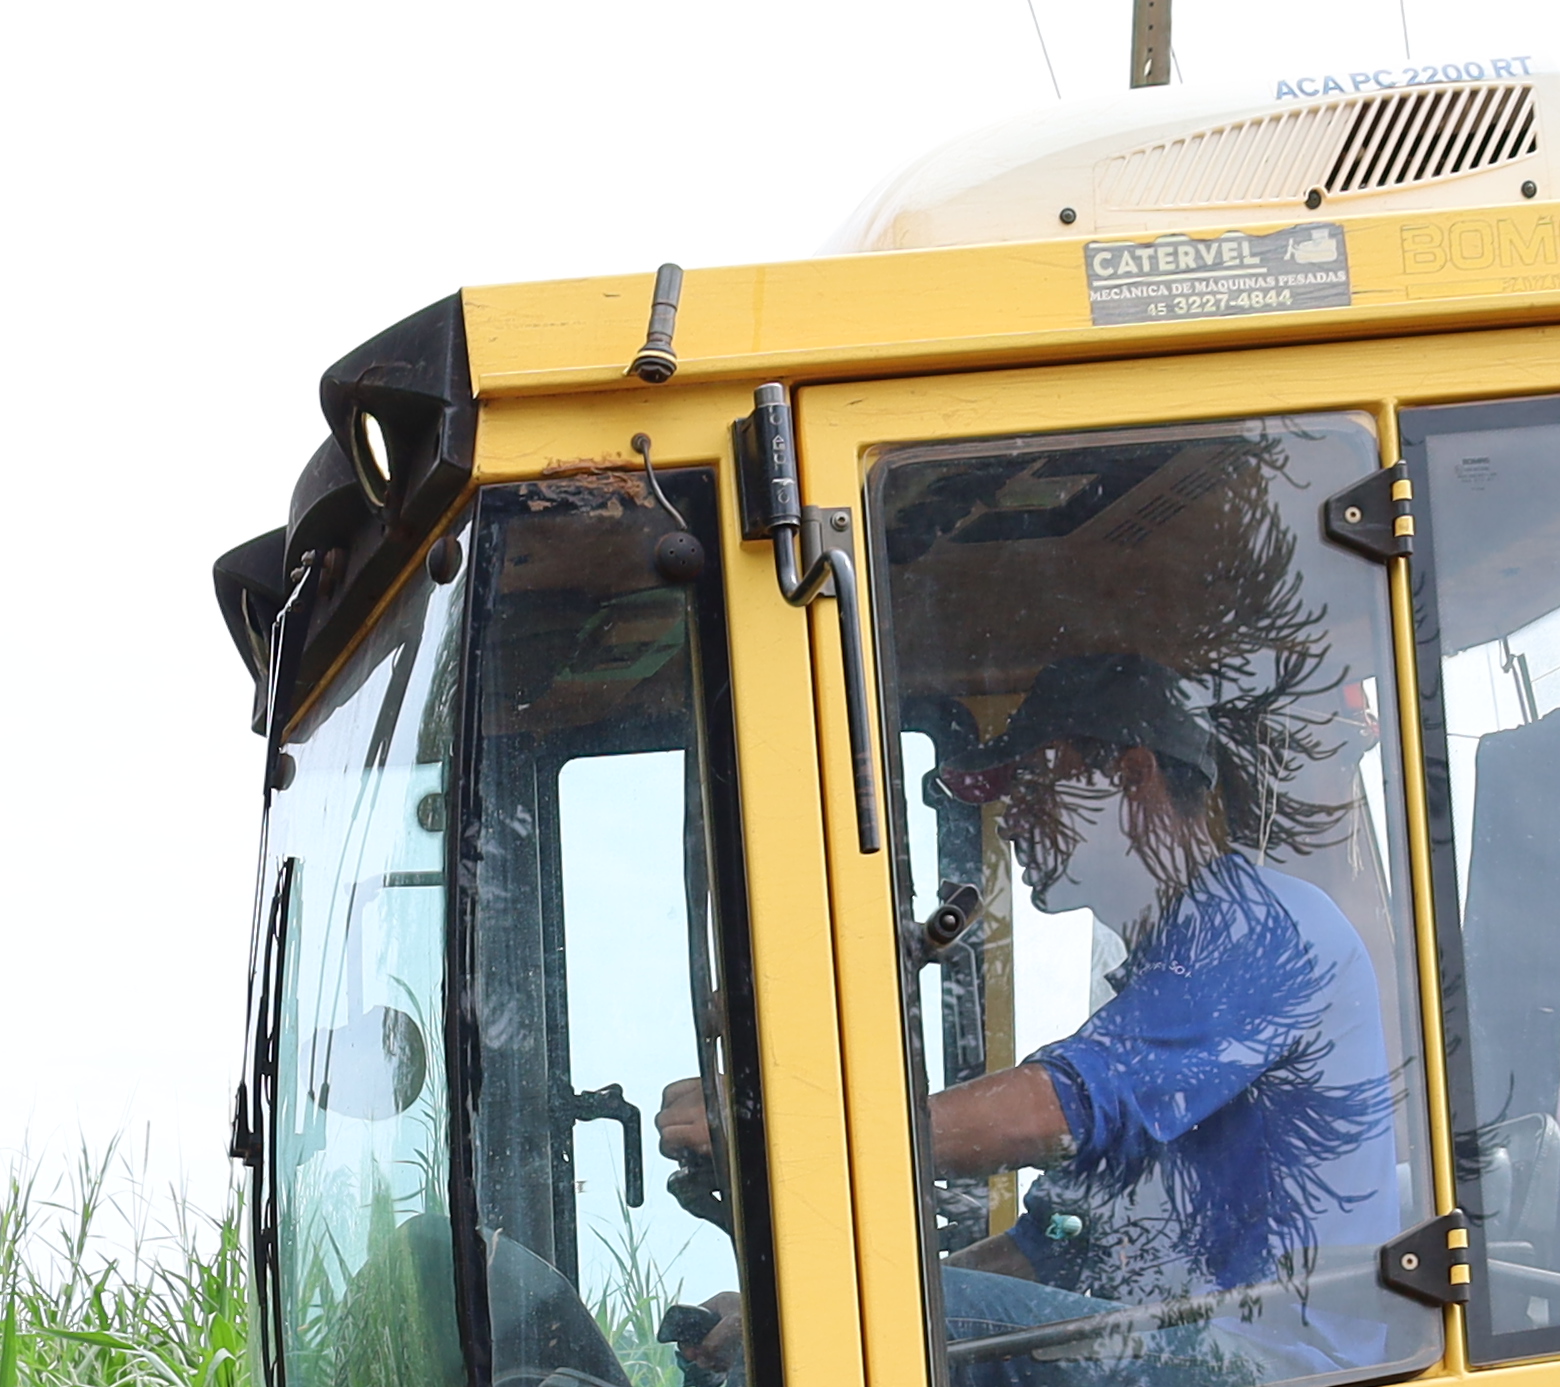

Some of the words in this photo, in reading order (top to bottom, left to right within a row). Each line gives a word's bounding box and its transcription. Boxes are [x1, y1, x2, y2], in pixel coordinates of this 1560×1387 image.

[1275, 74, 1345, 101] ACA
[1348, 70, 1397, 92] PC
[1402, 61, 1485, 87] 2200
[1490, 55, 1532, 78] RT
[1092, 240, 1261, 278] CATERVEL
[1090, 282, 1169, 302] MECÂNICA
[1171, 282, 1193, 295] DE
[1193, 276, 1276, 294] MÁQUINAS
[1277, 270, 1347, 287] PESADAS
[1147, 302, 1167, 317] 45
[1172, 289, 1293, 316] 3227-4844
